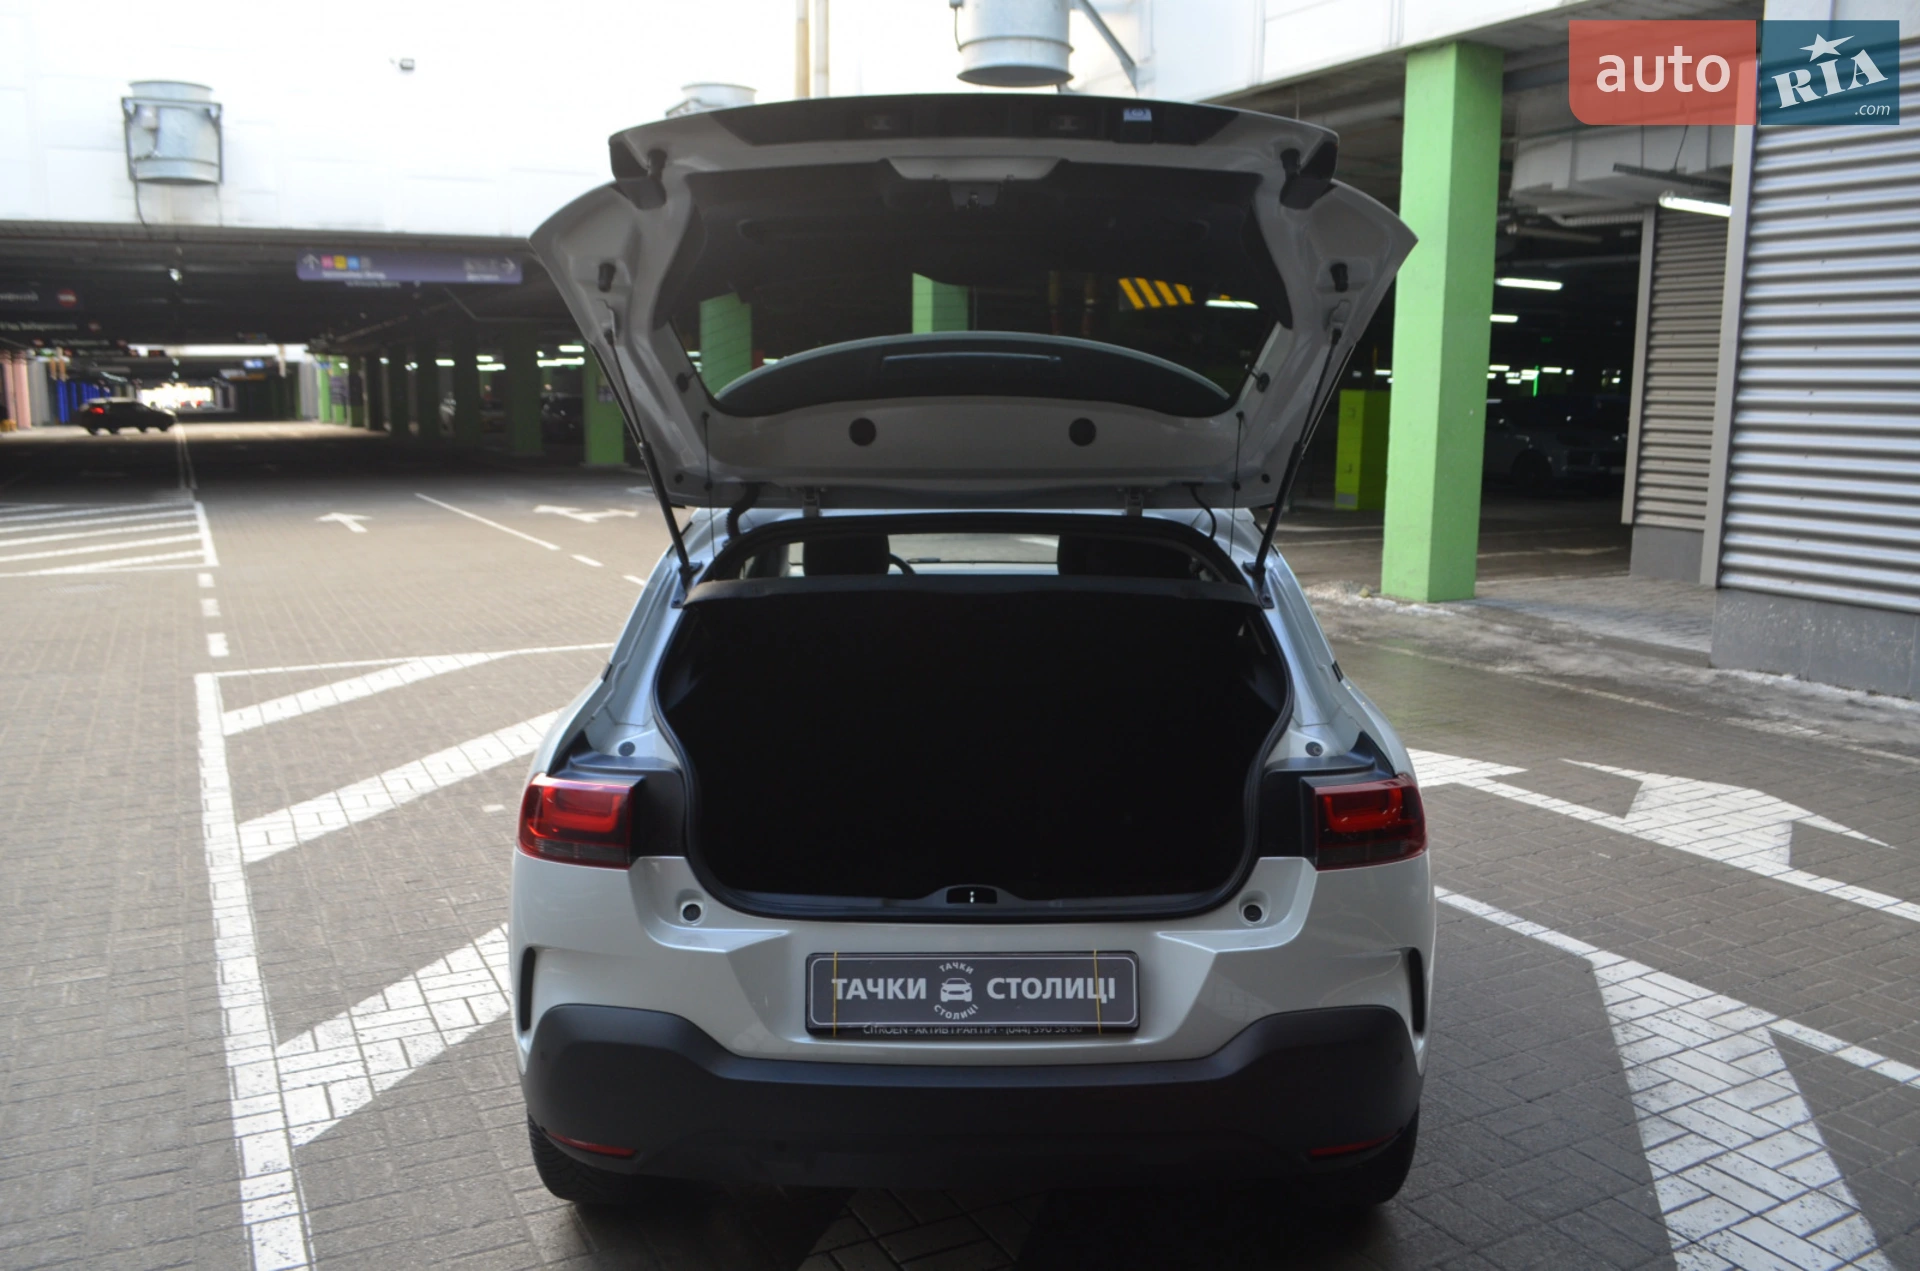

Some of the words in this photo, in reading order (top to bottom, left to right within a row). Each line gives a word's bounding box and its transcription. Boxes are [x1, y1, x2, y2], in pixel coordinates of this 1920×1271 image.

[939, 962, 974, 975] ТАЧКИ
[831, 977, 927, 1000] ТАЧКИ
[986, 977, 1116, 1004] СТОЛИЦІ
[934, 1004, 979, 1020] СТОЛИЦІ
